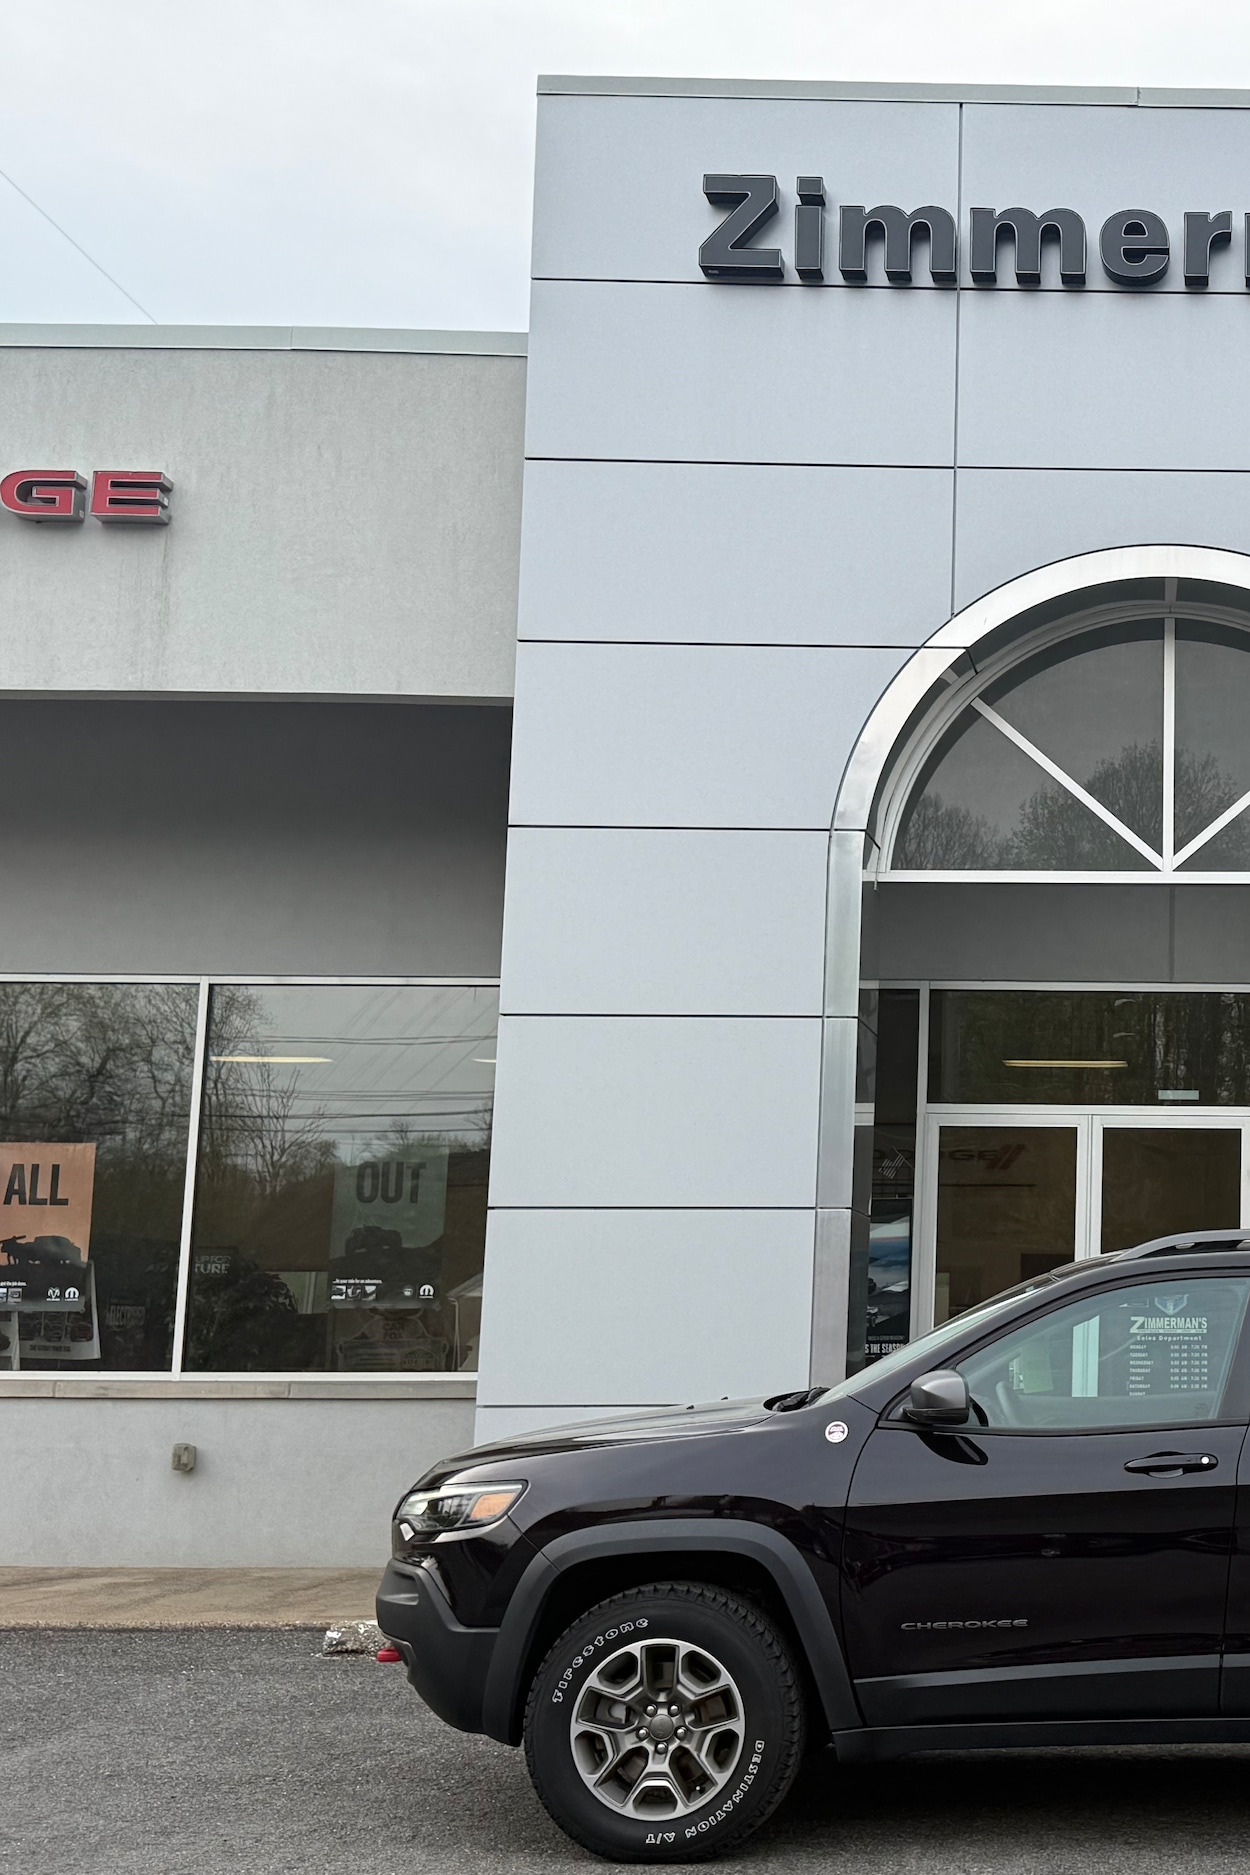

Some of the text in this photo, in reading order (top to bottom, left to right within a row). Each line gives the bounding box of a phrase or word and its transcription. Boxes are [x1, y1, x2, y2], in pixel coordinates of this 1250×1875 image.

[0, 469, 174, 526] GE
[3, 1163, 69, 1206] ALL
[356, 1161, 427, 1204] OUT
[1130, 1316, 1208, 1333] ZIMMERMAN'S
[870, 1343, 881, 1354] THE
[900, 1618, 1029, 1630] CHEROKEE
[552, 1618, 649, 1703] Firestone
[646, 1740, 765, 1844] DESTINATION A/T
